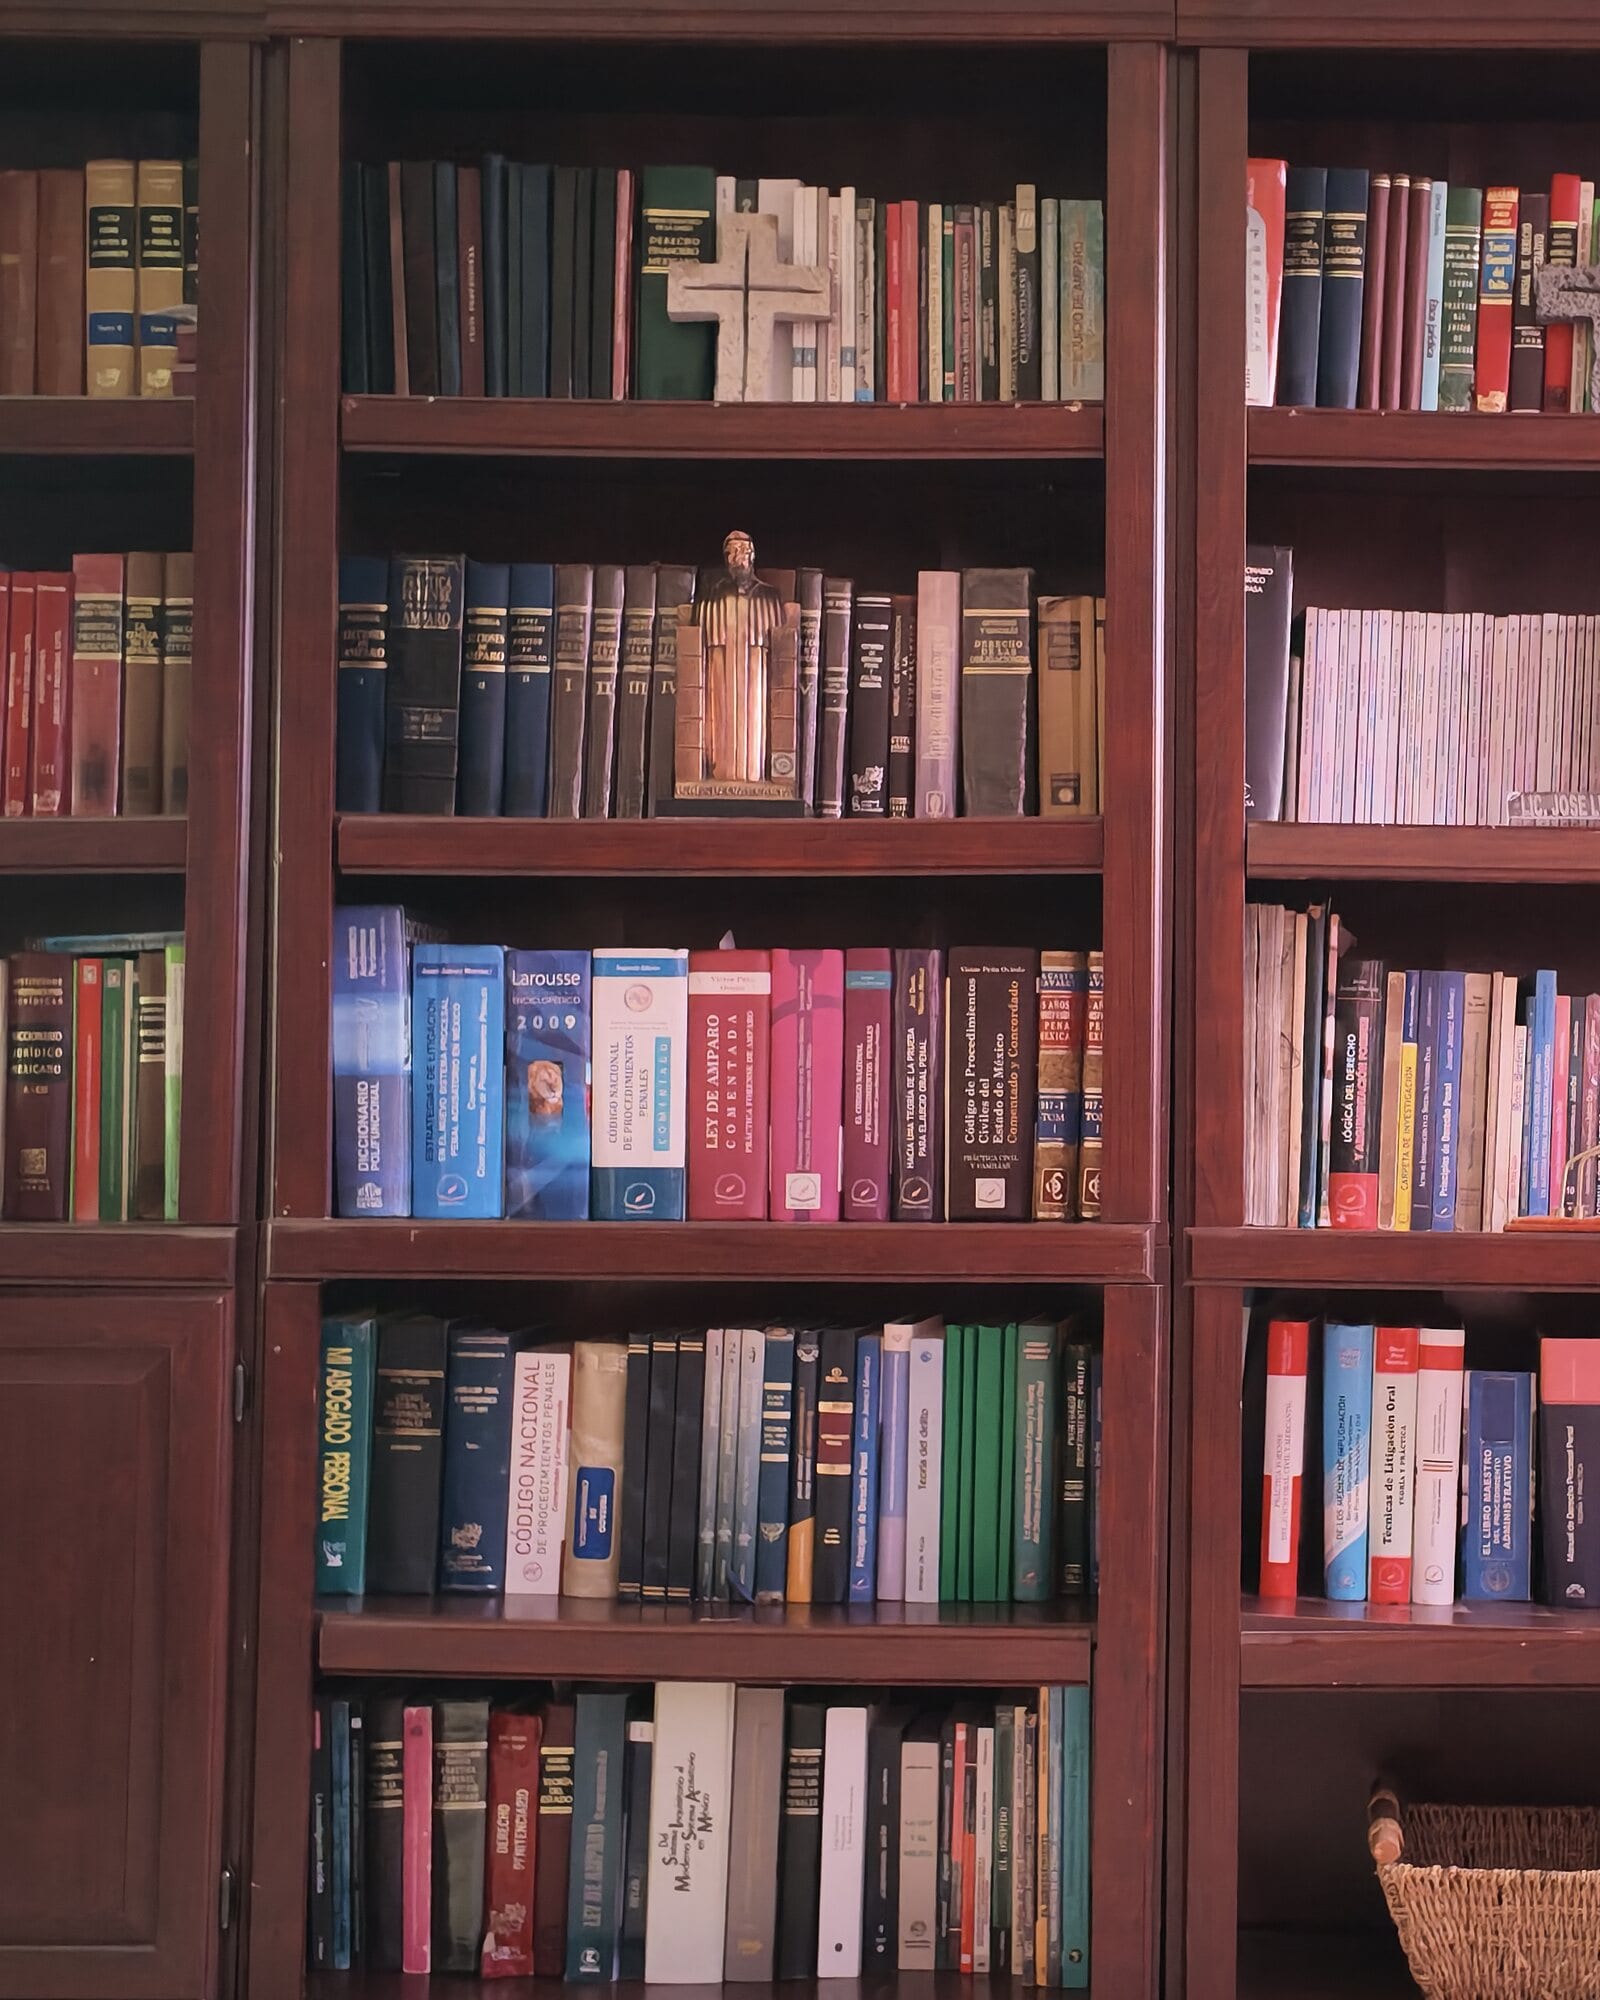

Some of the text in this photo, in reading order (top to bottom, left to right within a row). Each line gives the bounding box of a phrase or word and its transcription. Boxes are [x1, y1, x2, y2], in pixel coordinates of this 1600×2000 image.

[974, 640, 1023, 648] DERECHO
[629, 680, 647, 694] III
[1551, 793, 1588, 817] JOSE
[512, 969, 581, 986] Larousse
[906, 1028, 915, 1062] PRUEBA
[1044, 1022, 1070, 1031] PENA
[706, 1014, 719, 1149] LEY DE AMPARO
[725, 1014, 738, 1149] COMENTADA
[906, 1063, 915, 1074] LA
[965, 978, 977, 1144] Código de Procedimientos
[1007, 980, 1020, 1144] Comentado y Concordado
[607, 1042, 619, 1144] CÓDIGO NACIONAL
[623, 1034, 634, 1151] DE PROCEDIMIENTOS
[639, 1069, 648, 1117] PENALES
[979, 1078, 990, 1144] Civiles del
[993, 1032, 1004, 1144] Estado de México
[1341, 1033, 1357, 1143] LÓGICA DEL DERECHO
[1442, 1082, 1453, 1106] Penal
[357, 1081, 369, 1172] DICCIONARIO
[1041, 1112, 1065, 1121] TOM
[1400, 1066, 1413, 1191] CARPETA DE INVESTIGACIÓN
[906, 1142, 915, 1169] HACIA
[918, 1135, 927, 1157] PARA
[1439, 1155, 1450, 1197] Principios
[1567, 1186, 1575, 1195] 10
[322, 1347, 353, 1522] MI ABOGADO PERSONAL
[511, 1359, 540, 1555] CÓDIGO NACIONAL
[537, 1362, 555, 1555] DE PROCEDIMIENTOS PENALES
[918, 1409, 929, 1490] Teoría del delito
[1399, 1425, 1407, 1466] PRÁCTICA
[1382, 1385, 1396, 1545] Técnicas de Litigación Oral
[1398, 1475, 1406, 1506] TEORÍA
[1482, 1449, 1492, 1556] EL LIBRO MAESTRO
[1502, 1455, 1512, 1549] ADMINISTRATIVO
[1336, 1509, 1345, 1526] LOS
[1336, 1527, 1344, 1541] DE
[697, 1792, 713, 1833] México
